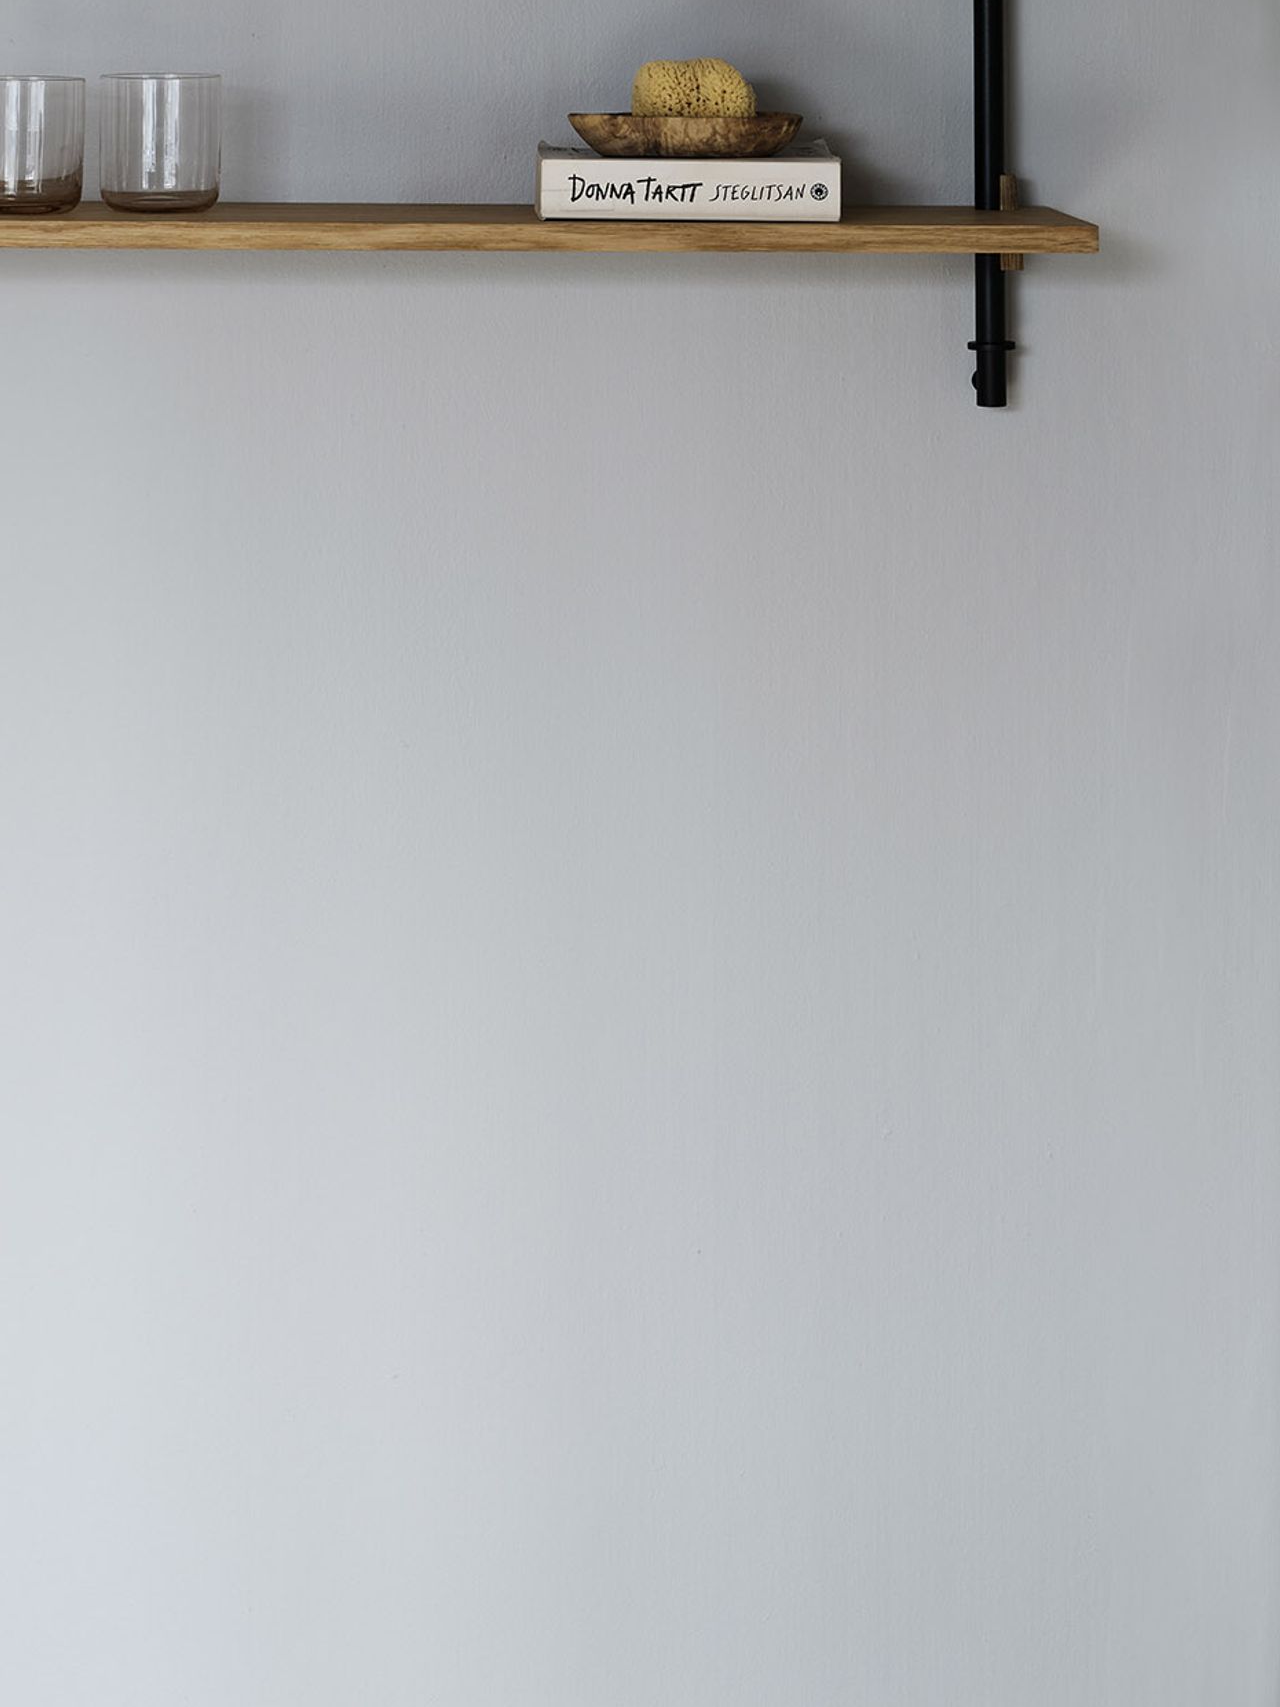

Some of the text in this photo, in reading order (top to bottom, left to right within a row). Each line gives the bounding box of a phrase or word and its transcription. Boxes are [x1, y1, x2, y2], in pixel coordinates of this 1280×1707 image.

[568, 173, 807, 205] DONNA TARTT STEGLITSAN
